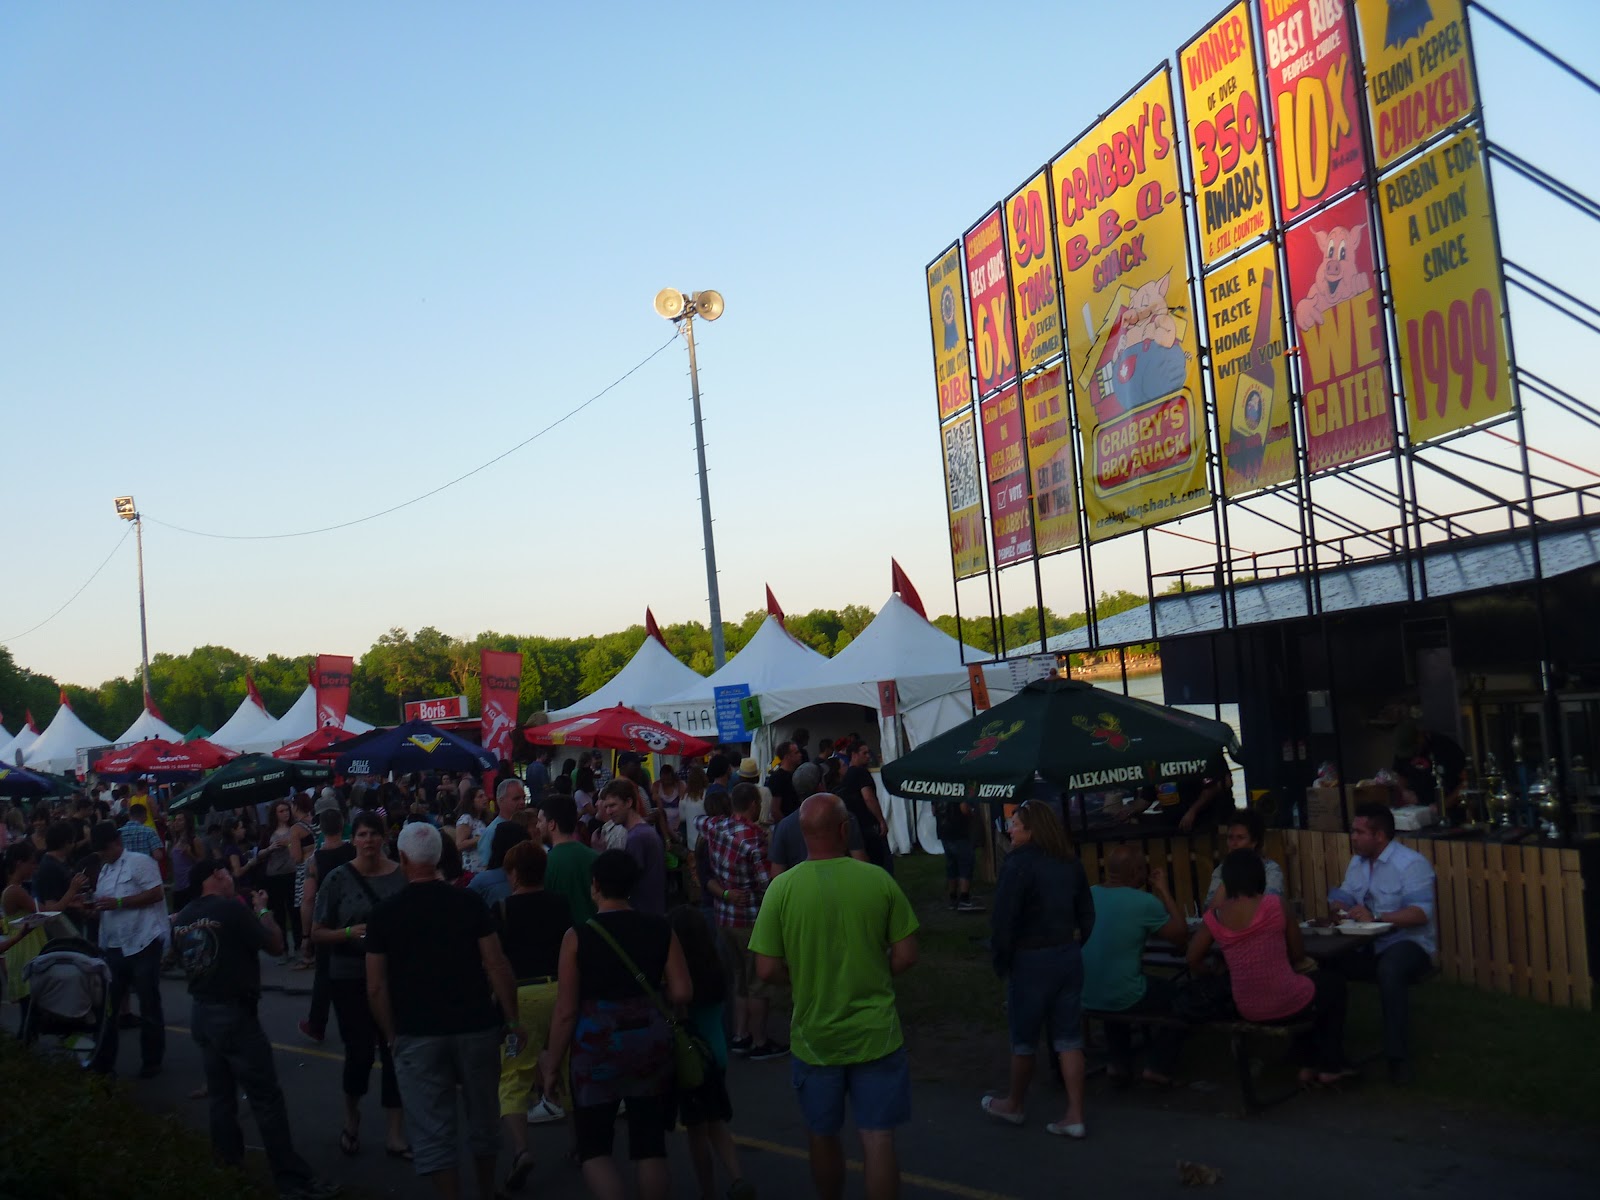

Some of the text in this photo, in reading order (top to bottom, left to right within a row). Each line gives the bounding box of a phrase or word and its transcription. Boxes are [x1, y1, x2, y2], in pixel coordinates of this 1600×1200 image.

[1187, 15, 1246, 90] WINNER
[1267, 9, 1305, 69] BEST
[1308, 0, 1343, 40] RIBS
[1281, 29, 1342, 84] PEOPLE'S CHOICE
[1372, 20, 1463, 106] LEMON PEPPER
[1207, 76, 1238, 111] OF OVER
[1378, 57, 1470, 160] CHICKEN
[1194, 90, 1259, 187] 350
[1278, 52, 1351, 210] 10X
[1061, 101, 1170, 227] CRABBY'S
[1385, 156, 1440, 214] RIBBIN
[1443, 136, 1478, 179] FOR
[1204, 160, 1263, 235] AWARDS
[1408, 181, 1469, 246] A LIVIN'
[1013, 190, 1046, 268] 30
[1066, 180, 1177, 272] B.B.Q.
[1217, 229, 1232, 253] STILL
[1233, 211, 1265, 243] COUNTING
[970, 264, 987, 299] BEST
[1092, 233, 1147, 293] SHACK
[1423, 233, 1469, 283] SINCE
[1017, 263, 1055, 320] TONS
[1210, 267, 1257, 304] TAKE A
[1036, 312, 1057, 337] EVERY
[1212, 297, 1252, 328] TASTE
[1301, 288, 1381, 385] WE
[977, 292, 1013, 384] 6X
[1030, 334, 1060, 362] SUMMER
[1214, 325, 1252, 355] HOME
[1217, 339, 1283, 380] WITH YOU
[1406, 287, 1498, 422] 1999
[940, 371, 970, 415] RIBS
[1306, 365, 1387, 437] CATER
[1101, 404, 1184, 457] CRABBY'S
[1101, 453, 1129, 481] BBQ
[1131, 432, 1187, 470] SHACK
[1008, 483, 1023, 502] VOTE
[994, 505, 1030, 538] CRABBY'S
[321, 674, 349, 685] Boris
[488, 677, 518, 689] Boris
[420, 702, 446, 719] Boris
[673, 708, 714, 731] THA
[221, 777, 256, 790] ALEXANDER
[900, 779, 1016, 798] ALEXANDER KEITH'S
[1068, 758, 1208, 791] ALEXANDER KEITH'S
